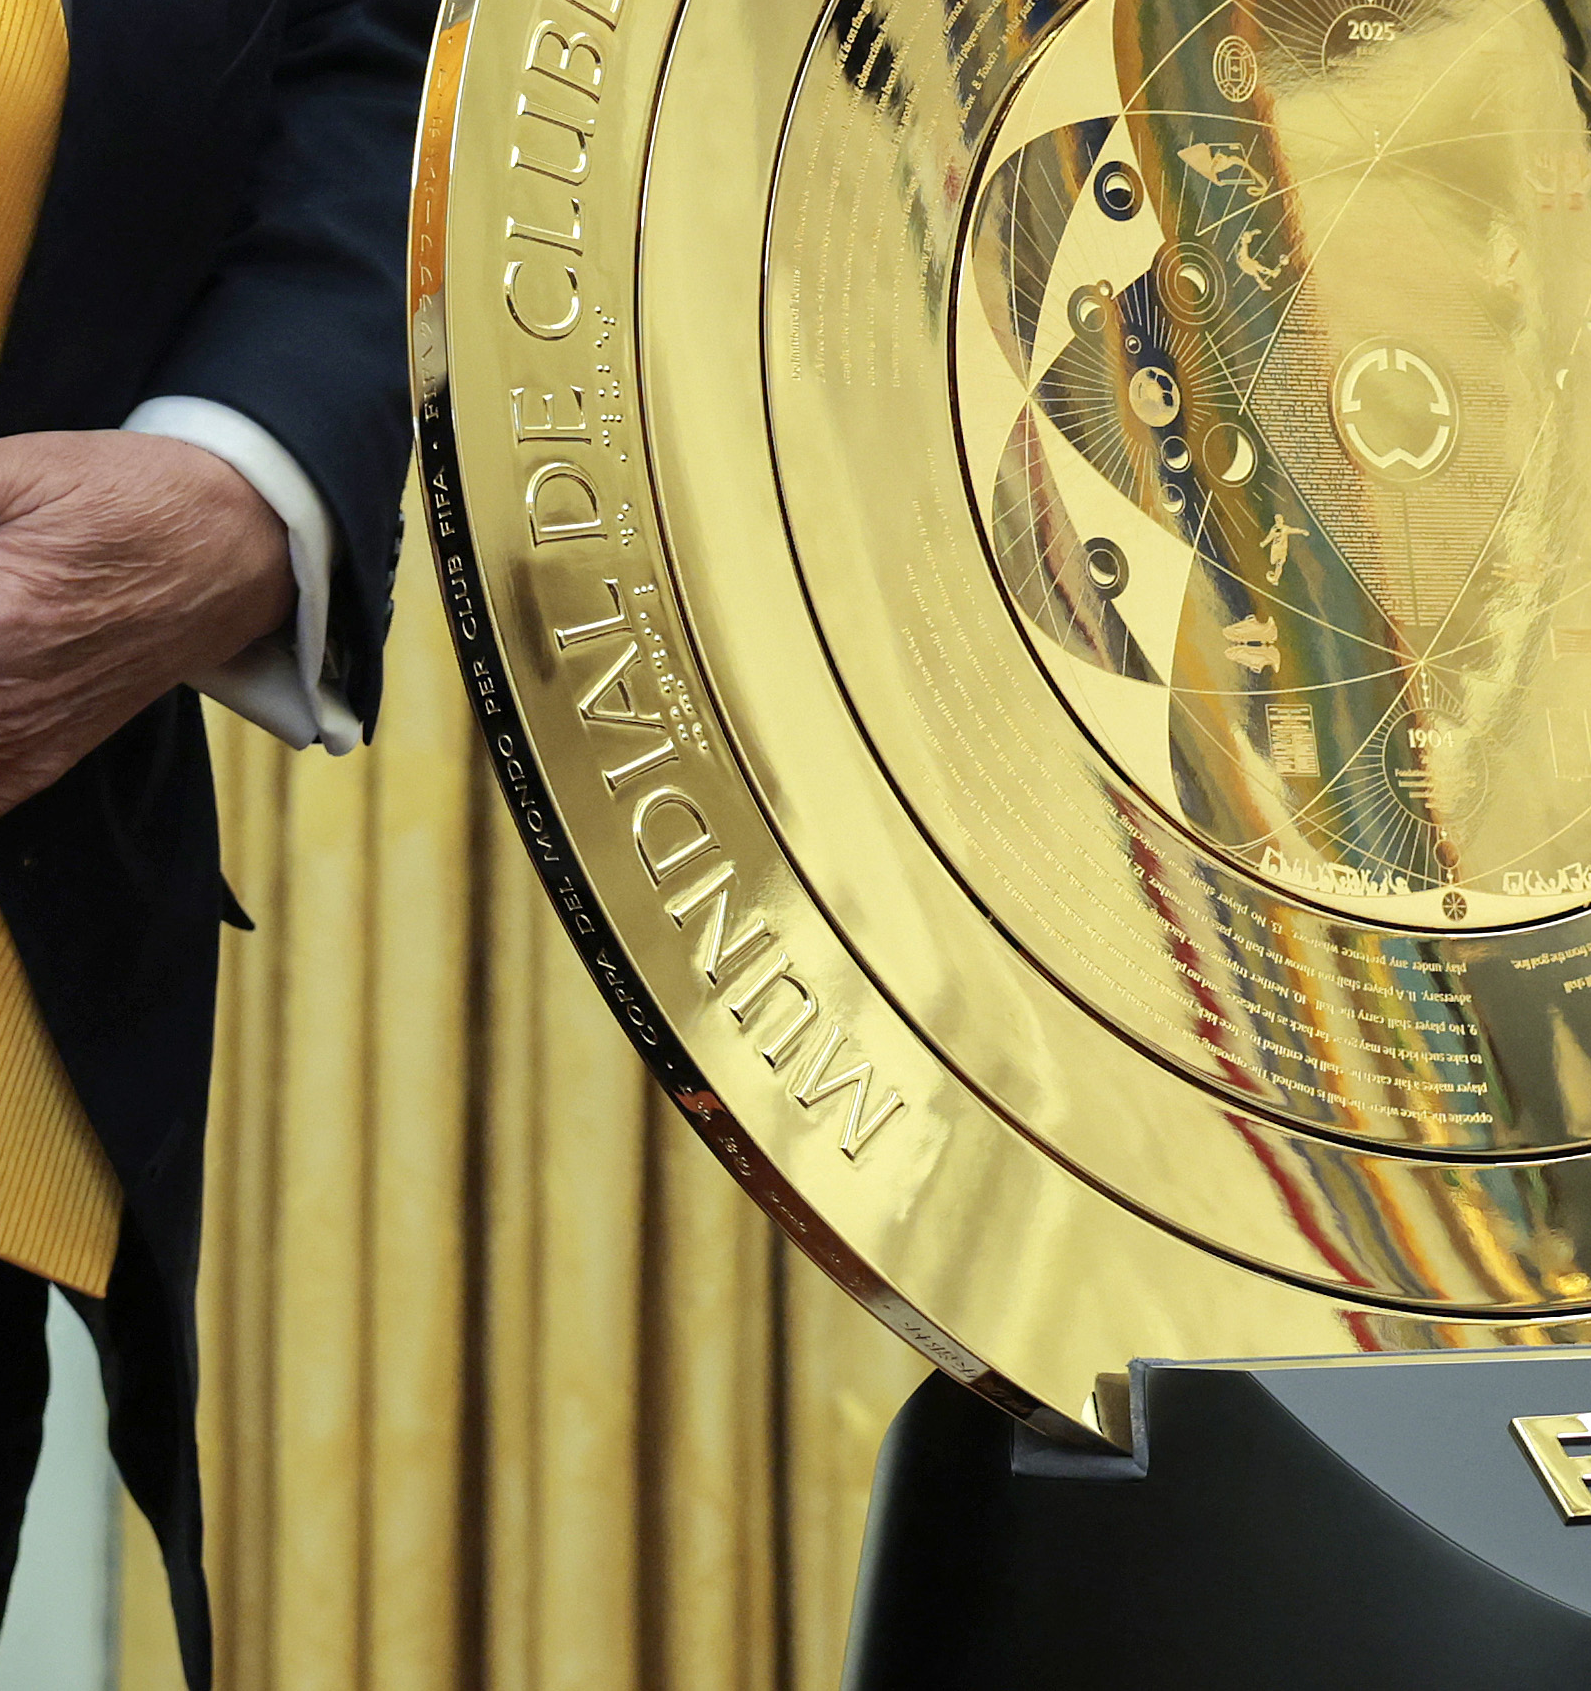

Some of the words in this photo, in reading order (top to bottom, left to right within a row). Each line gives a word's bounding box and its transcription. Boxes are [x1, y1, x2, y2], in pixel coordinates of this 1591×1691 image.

[850, 8, 866, 30] the
[941, 0, 966, 35] cannot
[1348, 20, 1396, 41] 2025
[976, 48, 999, 80] Touch
[510, 384, 609, 549] DE
[430, 463, 456, 538] FIFA
[445, 552, 480, 642] CLUB
[470, 654, 502, 715] PER
[1408, 728, 1454, 748] 1904
[495, 730, 561, 867] MONDO
[556, 577, 905, 1162] MUNDIAL
[1128, 859, 1146, 879] 12.
[554, 873, 597, 939] DEL
[1215, 889, 1249, 917] player
[1248, 909, 1267, 927] No
[1267, 918, 1283, 934] 13.
[1243, 938, 1265, 957] ball
[1264, 947, 1284, 965] the
[1388, 954, 1409, 969] any
[1411, 960, 1442, 973] under
[1444, 960, 1467, 974] play
[1247, 970, 1290, 998] Neither
[1361, 980, 1393, 998] player
[591, 944, 662, 1050] COPPA
[1420, 988, 1472, 1005] adversary.
[1259, 1006, 1276, 1023] he
[1386, 1016, 1411, 1030] shall
[1287, 1019, 1313, 1037] back
[1415, 1019, 1446, 1034] player
[1447, 1022, 1465, 1036] No
[1260, 1037, 1304, 1063] entitled
[1357, 1037, 1381, 1053] may
[1381, 1045, 1396, 1058] he
[1302, 1054, 1318, 1069] be
[1396, 1048, 1419, 1061] kick
[1420, 1051, 1444, 1063] such
[1446, 1052, 1469, 1065] take
[1267, 1070, 1315, 1098] touched.
[1393, 1076, 1412, 1089] fair
[1455, 1081, 1488, 1096] player
[1447, 1109, 1493, 1126] opposite
